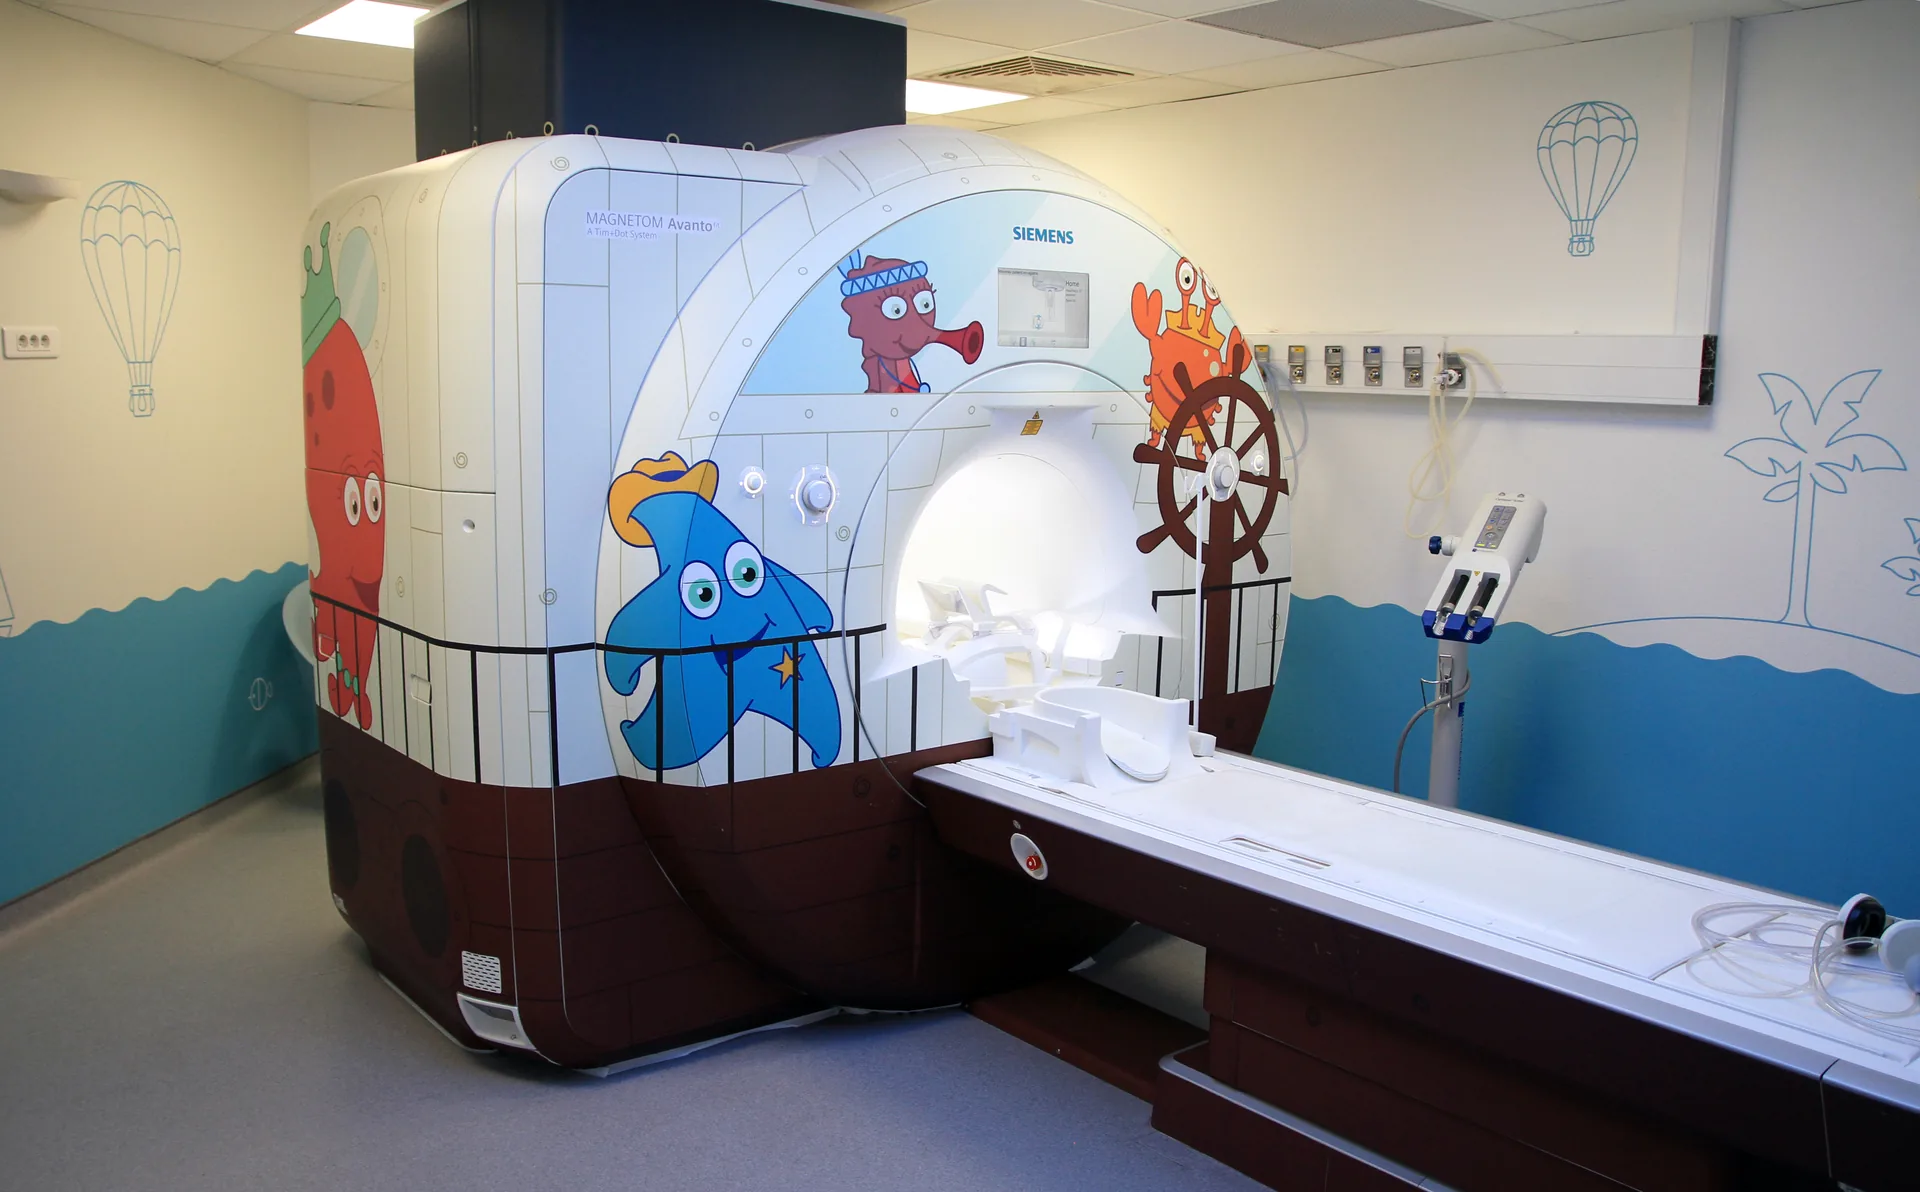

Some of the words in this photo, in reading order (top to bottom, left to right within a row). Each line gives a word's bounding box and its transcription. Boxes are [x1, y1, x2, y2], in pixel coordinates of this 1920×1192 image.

[586, 212, 663, 229] MAGNETOM
[587, 228, 593, 236] A
[595, 228, 628, 238] Tim+Dot
[630, 230, 657, 240] System
[1012, 226, 1074, 244] SIEMENS
